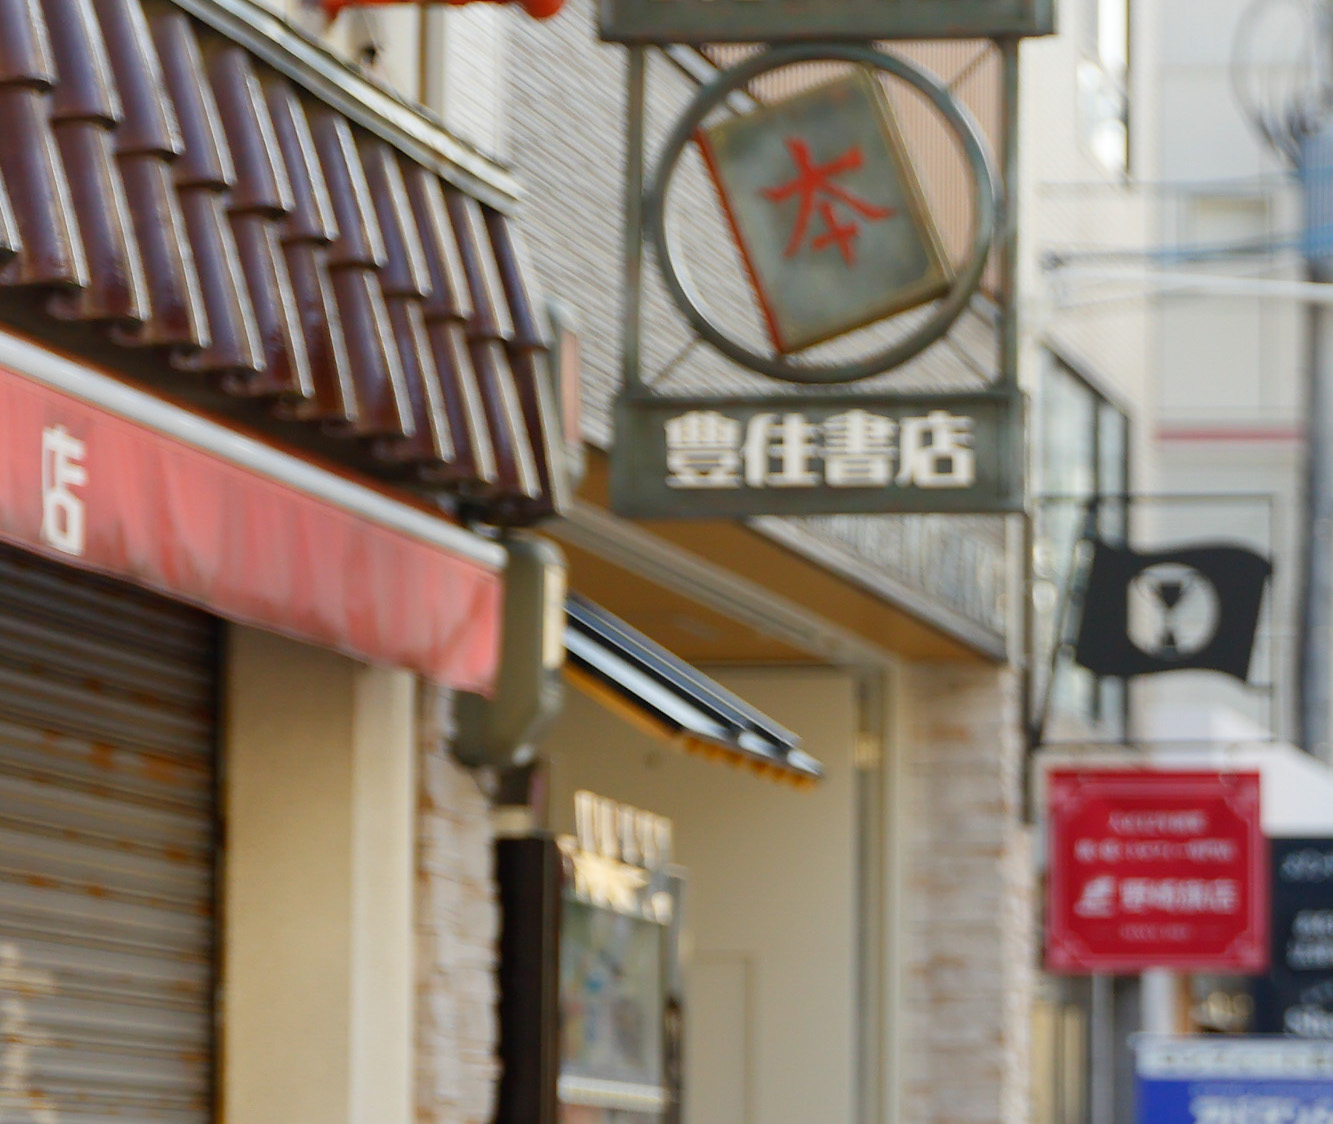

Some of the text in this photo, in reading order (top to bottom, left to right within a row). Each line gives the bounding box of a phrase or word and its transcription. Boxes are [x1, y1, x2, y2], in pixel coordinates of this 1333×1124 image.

[758, 136, 898, 267] 本
[42, 427, 86, 555] 店
[665, 410, 977, 490] 豊住書店
